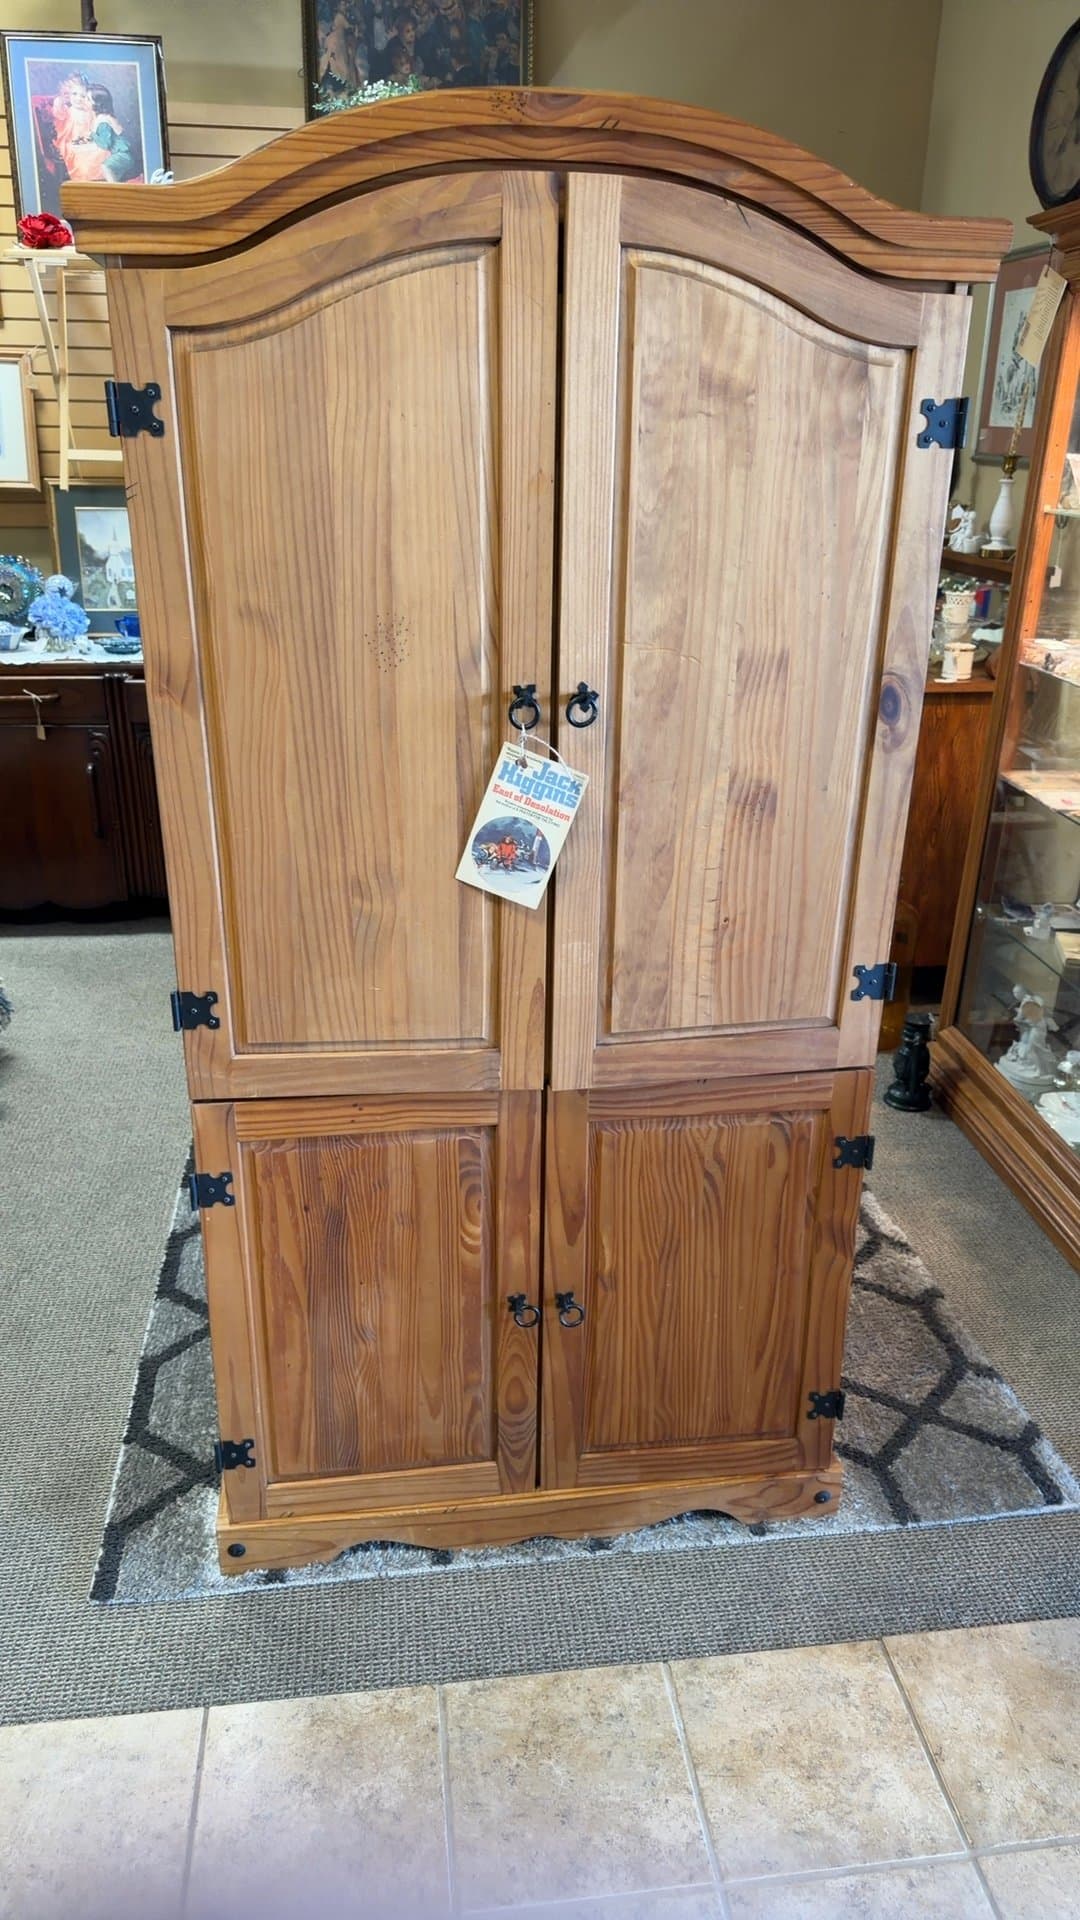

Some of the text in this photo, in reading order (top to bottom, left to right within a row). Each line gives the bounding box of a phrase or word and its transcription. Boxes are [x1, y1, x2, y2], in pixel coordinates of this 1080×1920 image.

[498, 760, 579, 808] Higgins
[532, 761, 583, 796] Jack
[492, 783, 515, 799] East
[514, 794, 525, 804] of
[524, 796, 571, 821] Desolation
